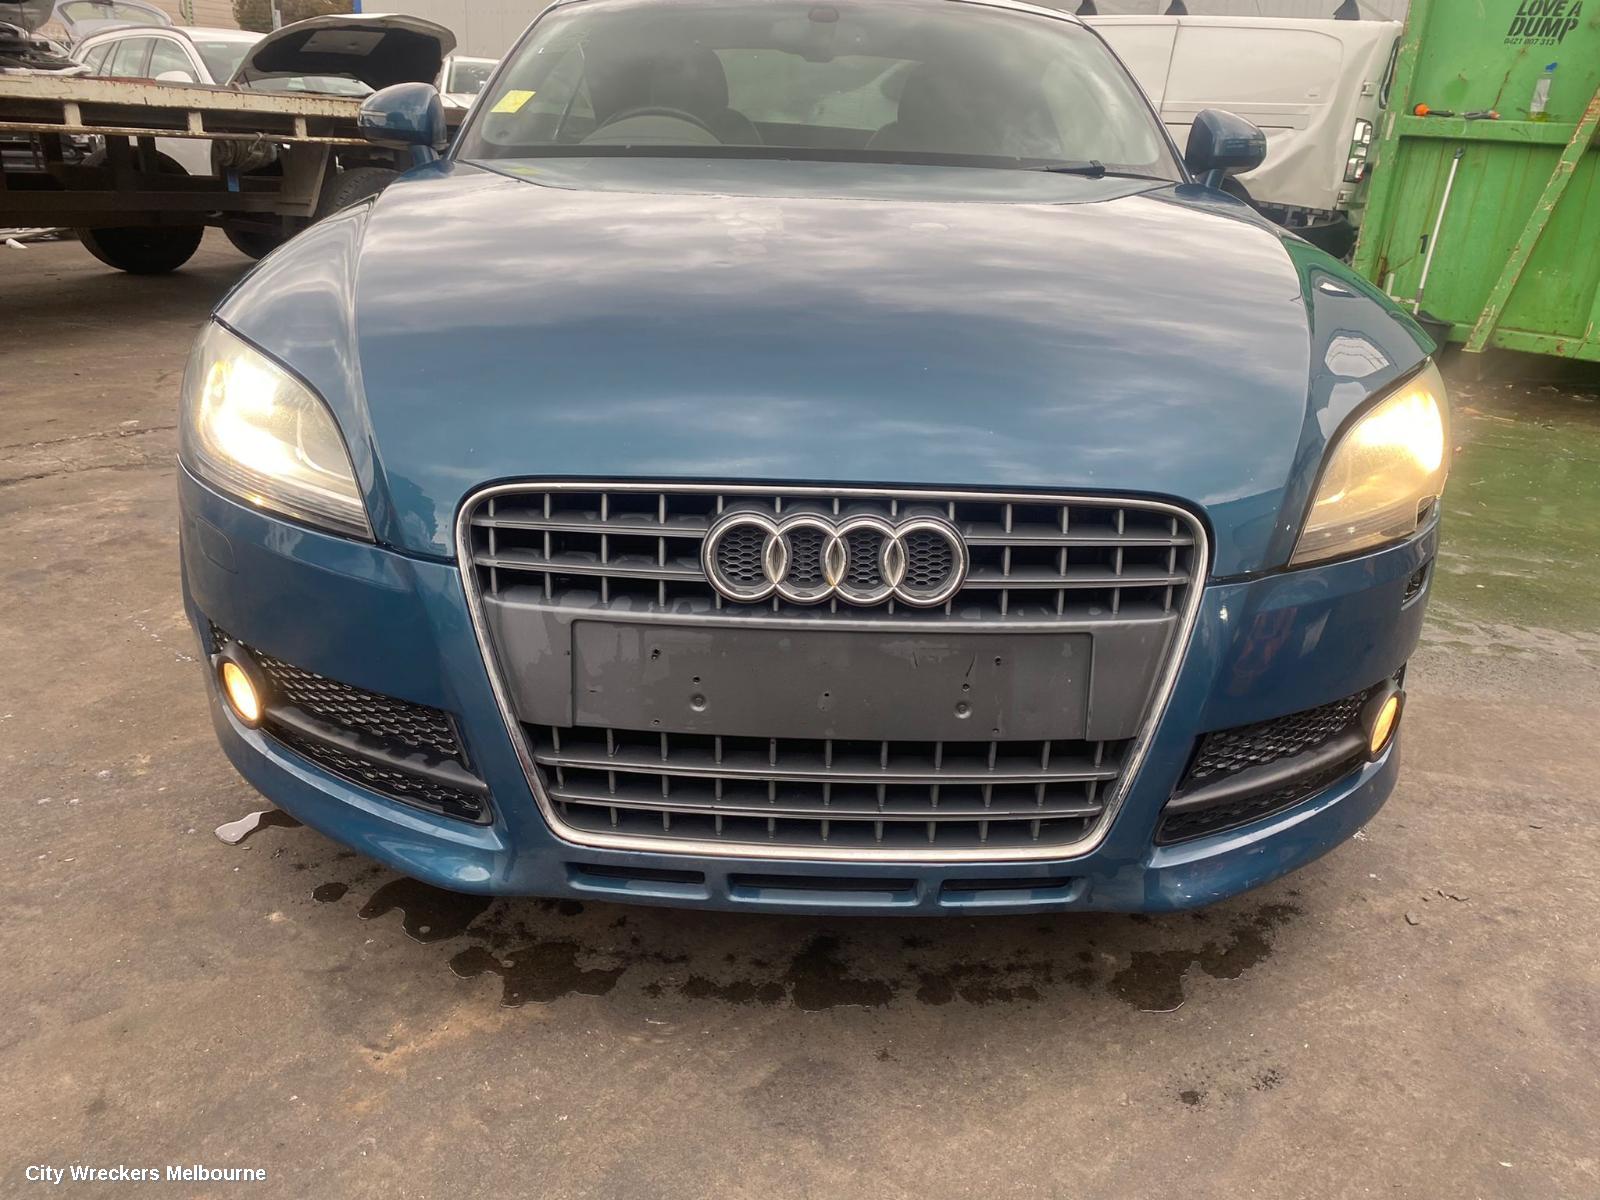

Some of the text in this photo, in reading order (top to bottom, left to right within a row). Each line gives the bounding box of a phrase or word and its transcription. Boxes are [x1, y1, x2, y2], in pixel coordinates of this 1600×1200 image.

[1515, 0, 1582, 17] LOVE A
[1507, 17, 1578, 45] DUMP
